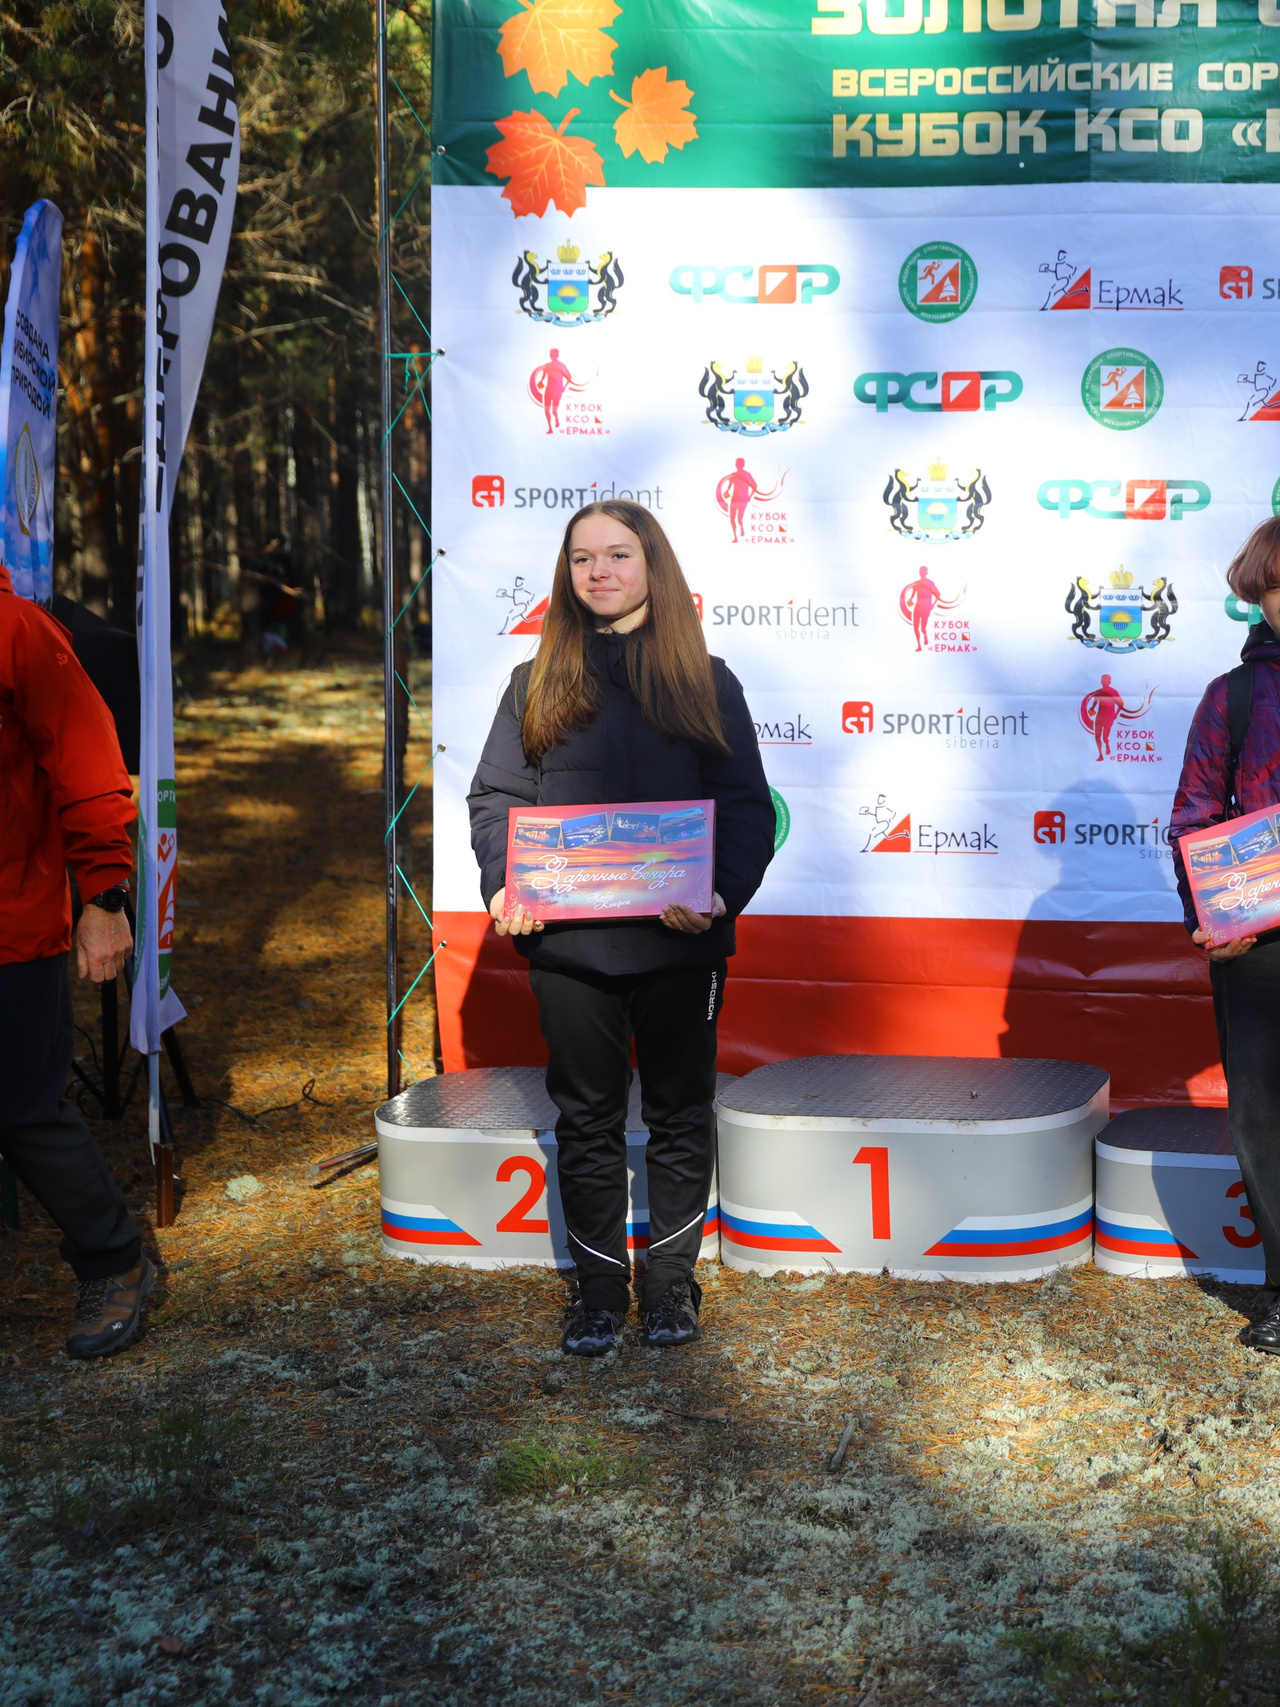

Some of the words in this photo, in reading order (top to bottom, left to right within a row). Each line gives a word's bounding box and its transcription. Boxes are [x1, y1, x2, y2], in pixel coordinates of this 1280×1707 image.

[832, 58, 1173, 97] ВСЕРОССИЙСКИЕ
[832, 109, 1047, 158] КУБОК
[1074, 108, 1202, 153] КСО
[1099, 279, 1183, 311] Ермак
[13, 337, 56, 396] ИБИРСКОЙ
[11, 365, 51, 419] ПРИРОДОЙ
[565, 403, 603, 412] КУБОК
[565, 415, 590, 424] КСО
[751, 512, 787, 521] КУБОК
[751, 524, 774, 532] КСО
[712, 598, 859, 627] SPORTident
[934, 620, 970, 629] КУБОК
[775, 628, 830, 640] siberia
[934, 632, 957, 641] КСО
[882, 707, 1029, 736] SPORTident
[1116, 730, 1155, 740] КУБОК
[945, 737, 999, 749] siberia
[1116, 742, 1141, 751] КСО
[918, 823, 999, 855] Ермак
[1139, 848, 1172, 859] sibe
[531, 854, 629, 893] Заречные
[495, 1155, 549, 1234] 2
[852, 1146, 890, 1240] 1
[1222, 1180, 1263, 1249] 3
